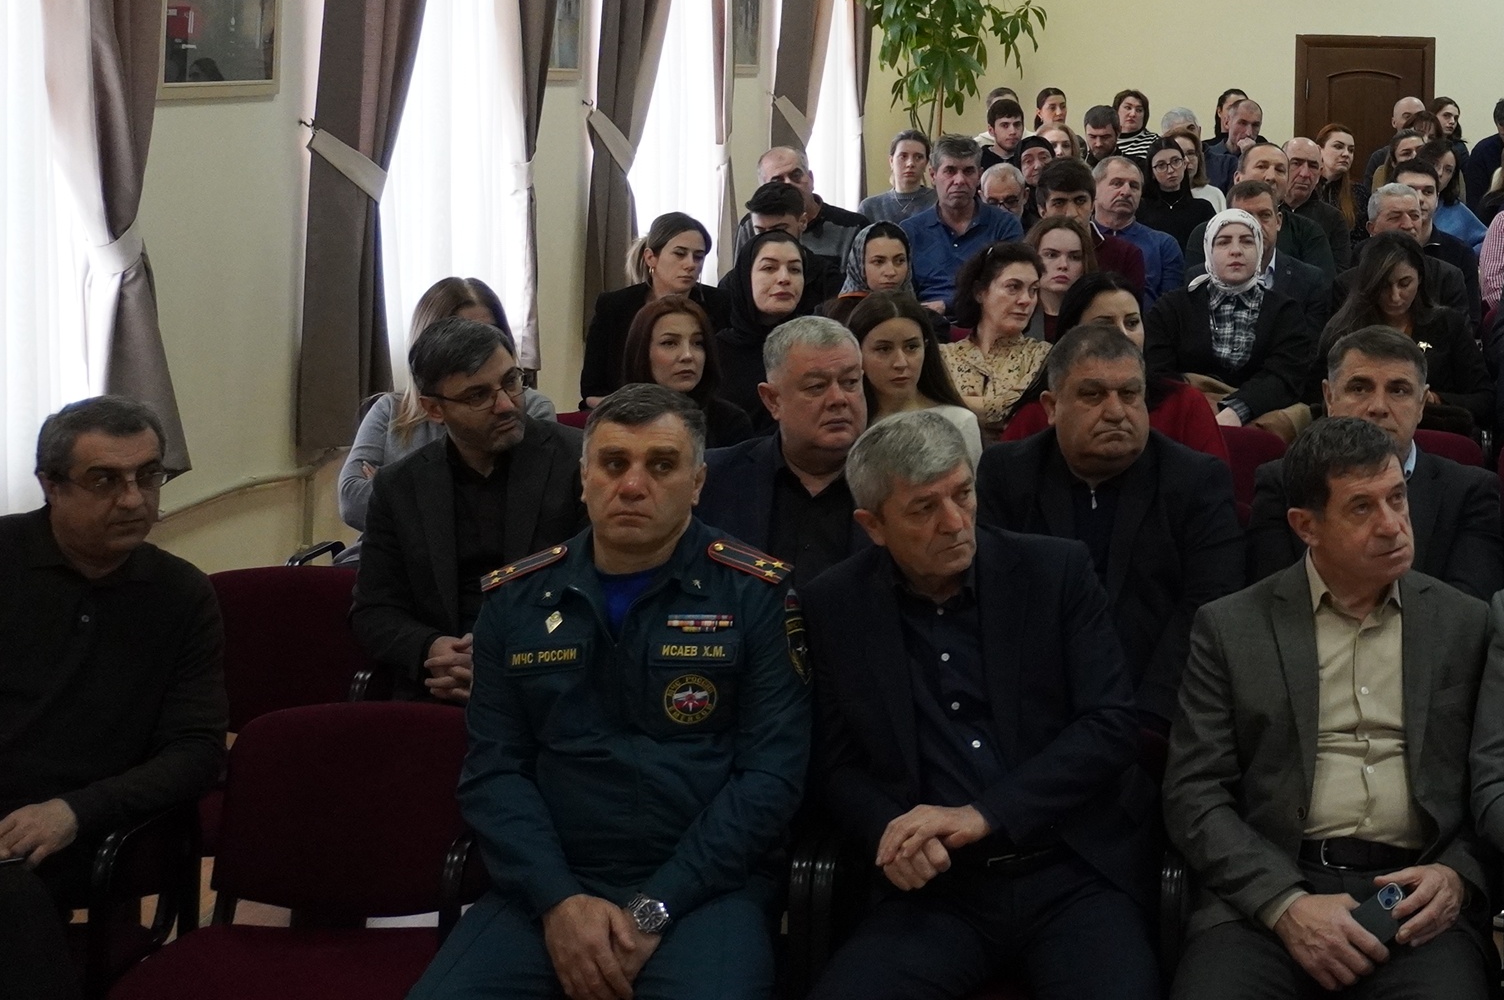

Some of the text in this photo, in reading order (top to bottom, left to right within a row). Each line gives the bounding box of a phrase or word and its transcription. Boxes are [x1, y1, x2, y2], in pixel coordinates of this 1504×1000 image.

[511, 648, 577, 666] МЧС РОССИИ
[661, 644, 726, 658] ИСАЕВ Х.М.
